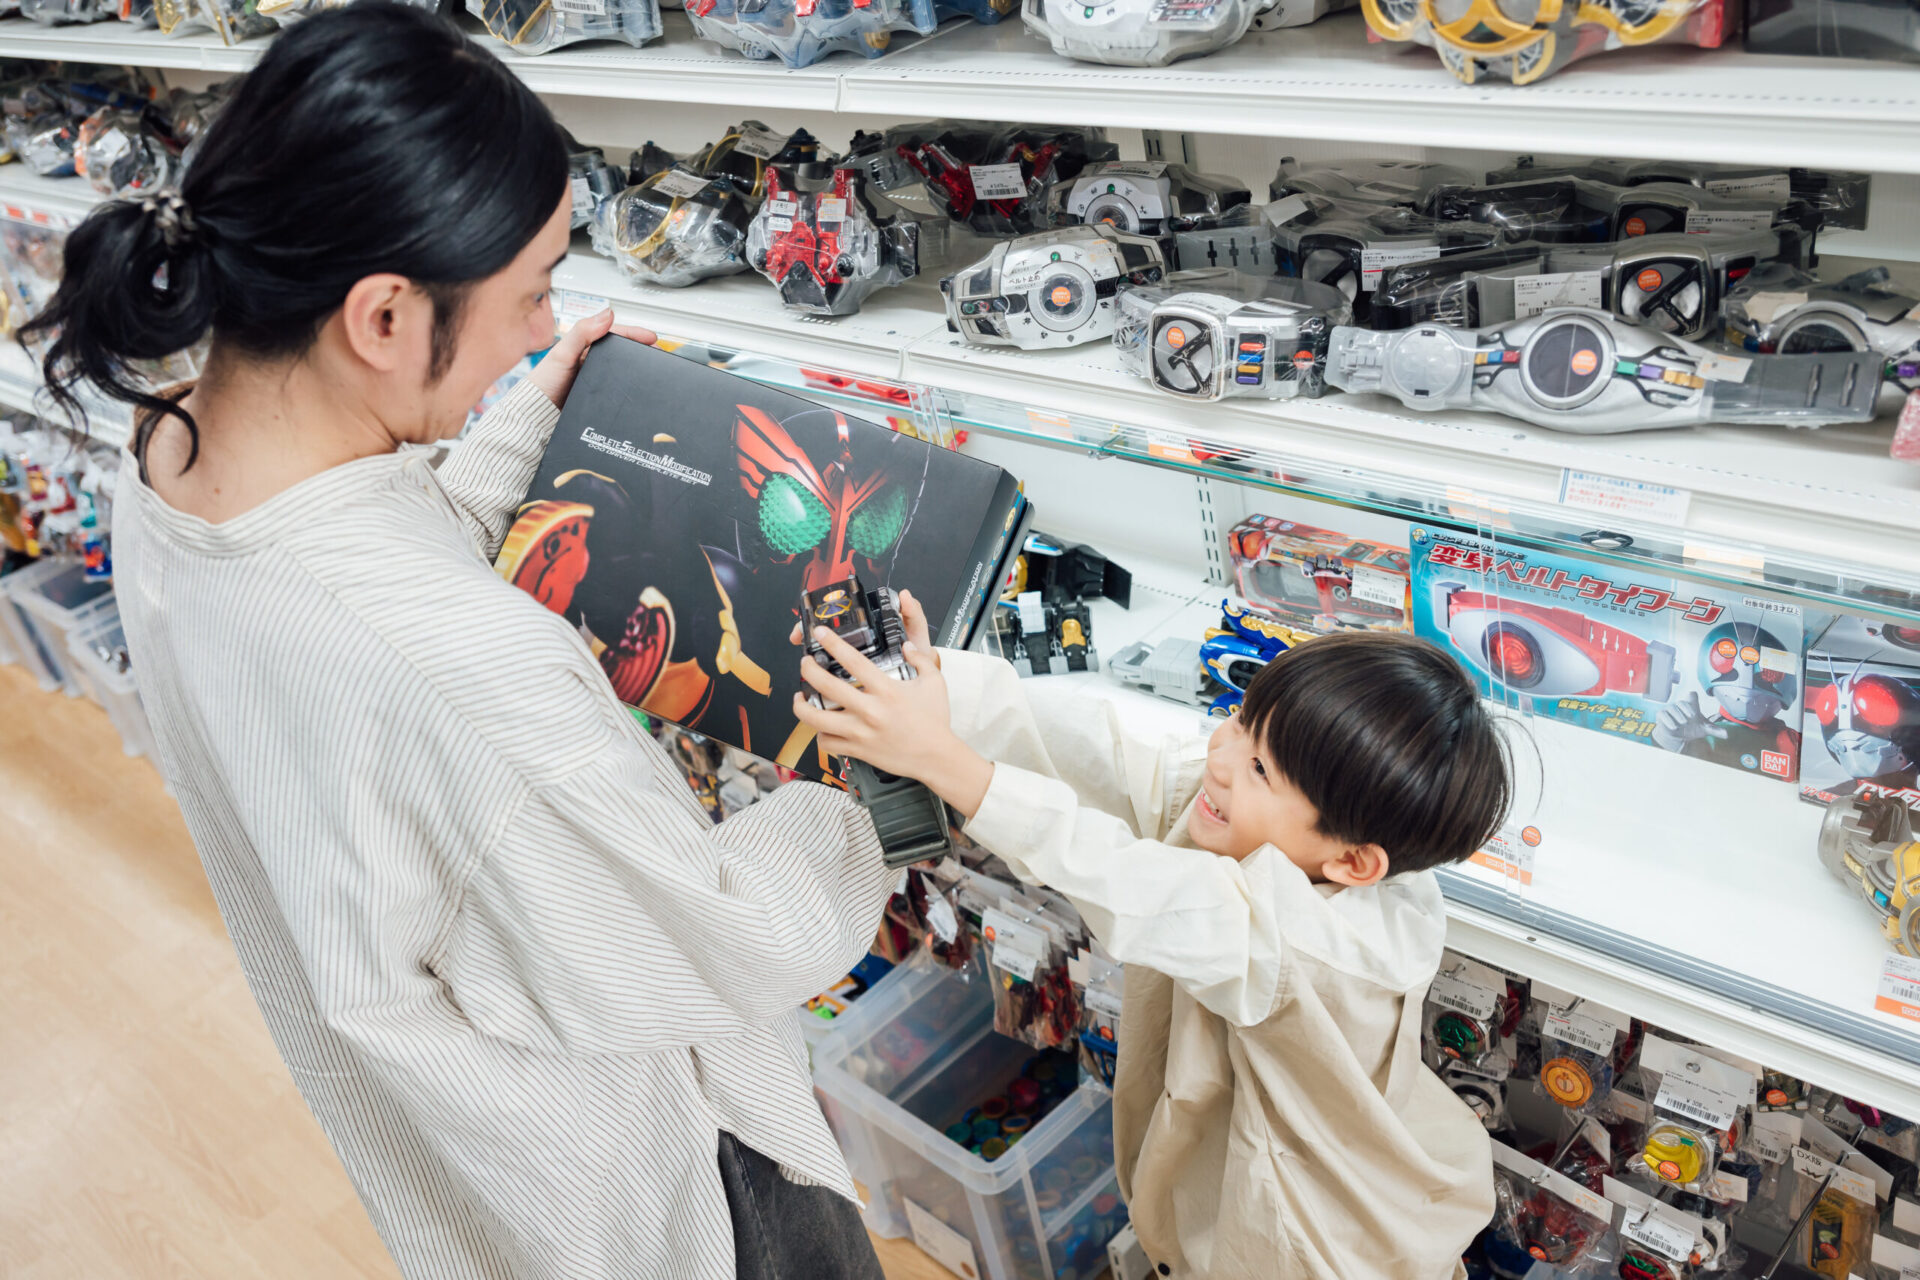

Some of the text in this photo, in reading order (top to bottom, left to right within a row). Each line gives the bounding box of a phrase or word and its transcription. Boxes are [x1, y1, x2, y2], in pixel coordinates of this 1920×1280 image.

[1009, 273, 1041, 285] ベルト止め
[1428, 543, 1725, 625] 変身ベルトタイフーン
[1765, 754, 1786, 766] BAN
[1765, 761, 1782, 772] DAI
